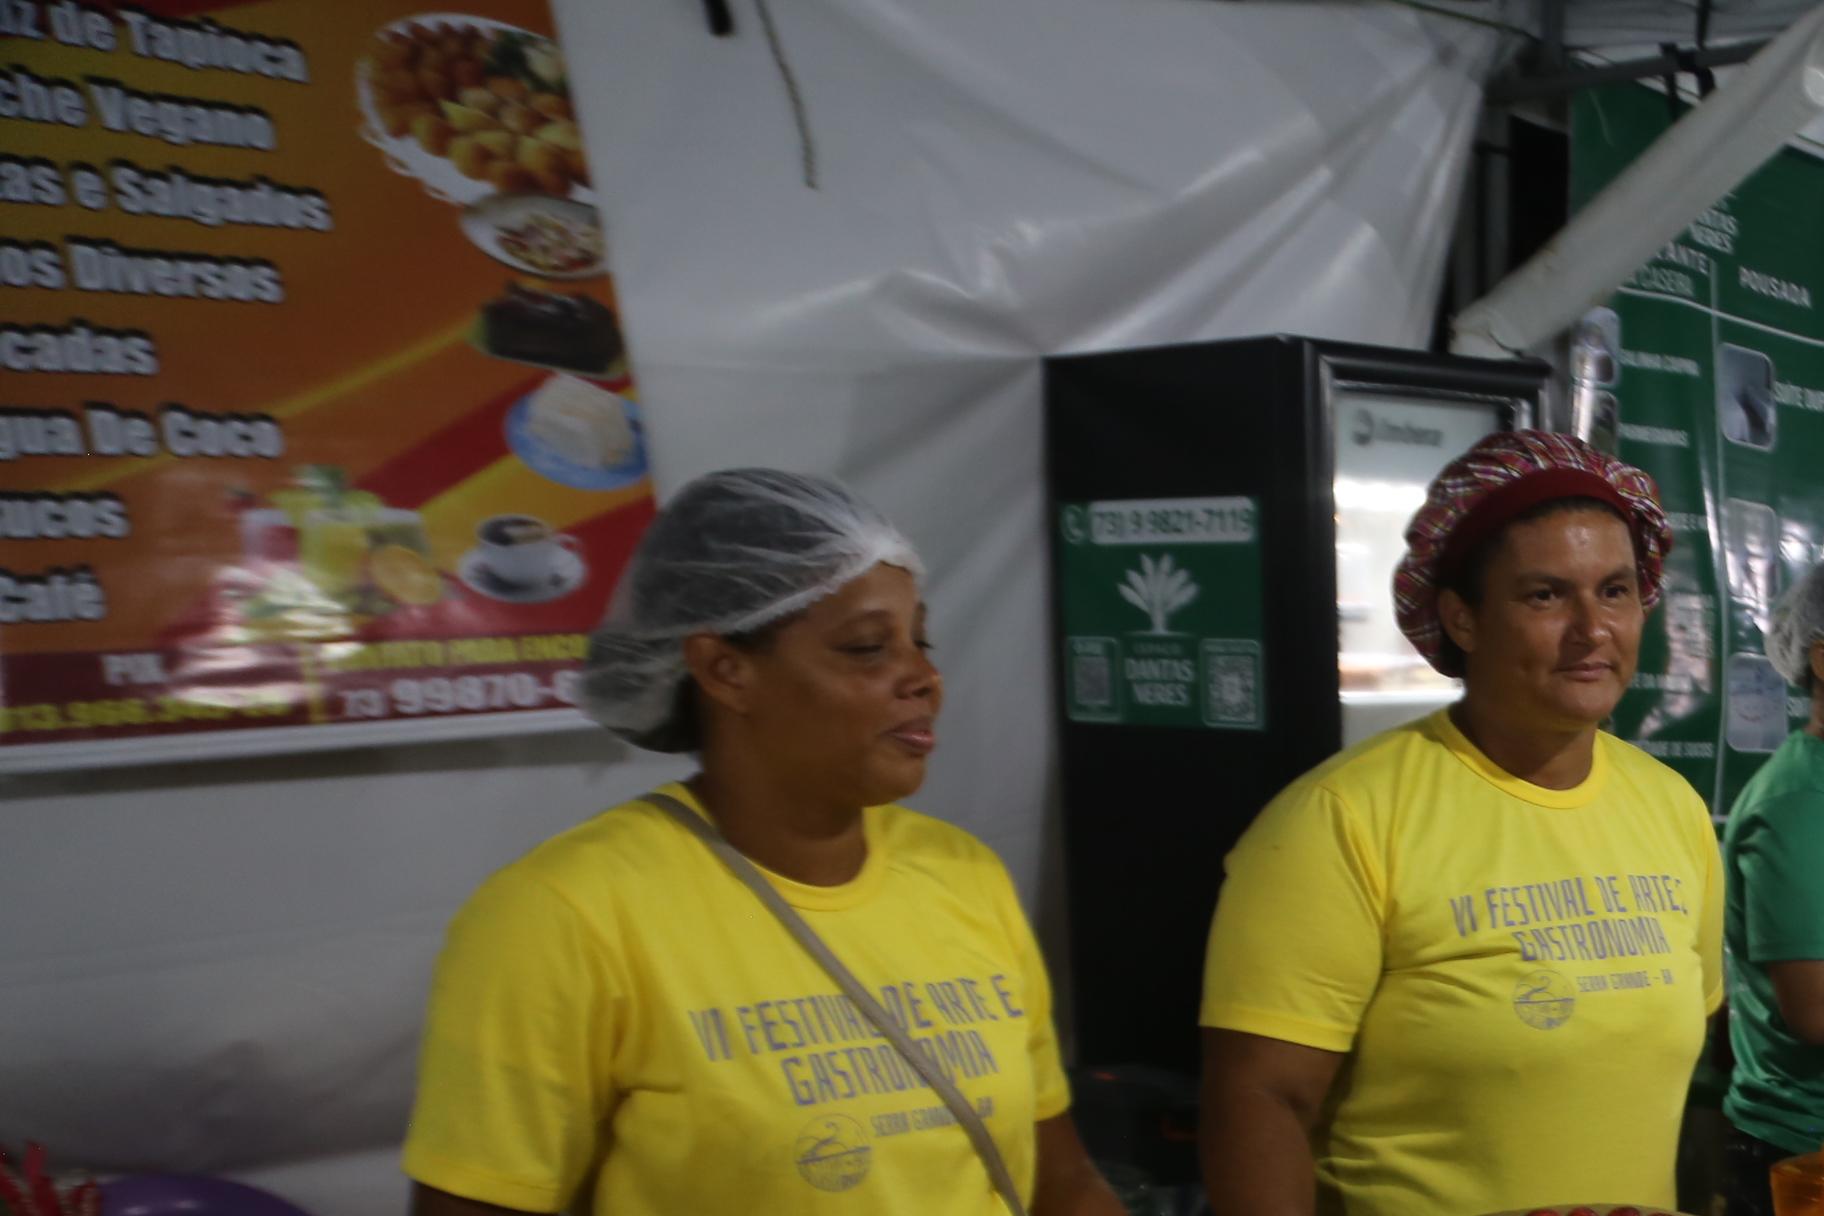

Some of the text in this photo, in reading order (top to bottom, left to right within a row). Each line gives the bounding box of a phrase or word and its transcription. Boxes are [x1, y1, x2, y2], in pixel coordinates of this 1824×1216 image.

[51, 0, 117, 52] de
[119, 8, 311, 83] Tapioca
[85, 78, 277, 150] Vegano
[69, 162, 110, 211] e
[108, 160, 334, 232] Salgados
[65, 236, 286, 304] Diversos
[1738, 265, 1813, 310] POUSADA
[84, 402, 159, 456] De
[159, 402, 286, 458] Coco
[1450, 895, 1478, 937] VI
[1485, 877, 1595, 929] FESTIVAL
[1595, 876, 1627, 913] DE
[1512, 918, 1672, 961] GASTRONOMIA
[881, 982, 934, 1031] DE
[991, 974, 1024, 1017] E
